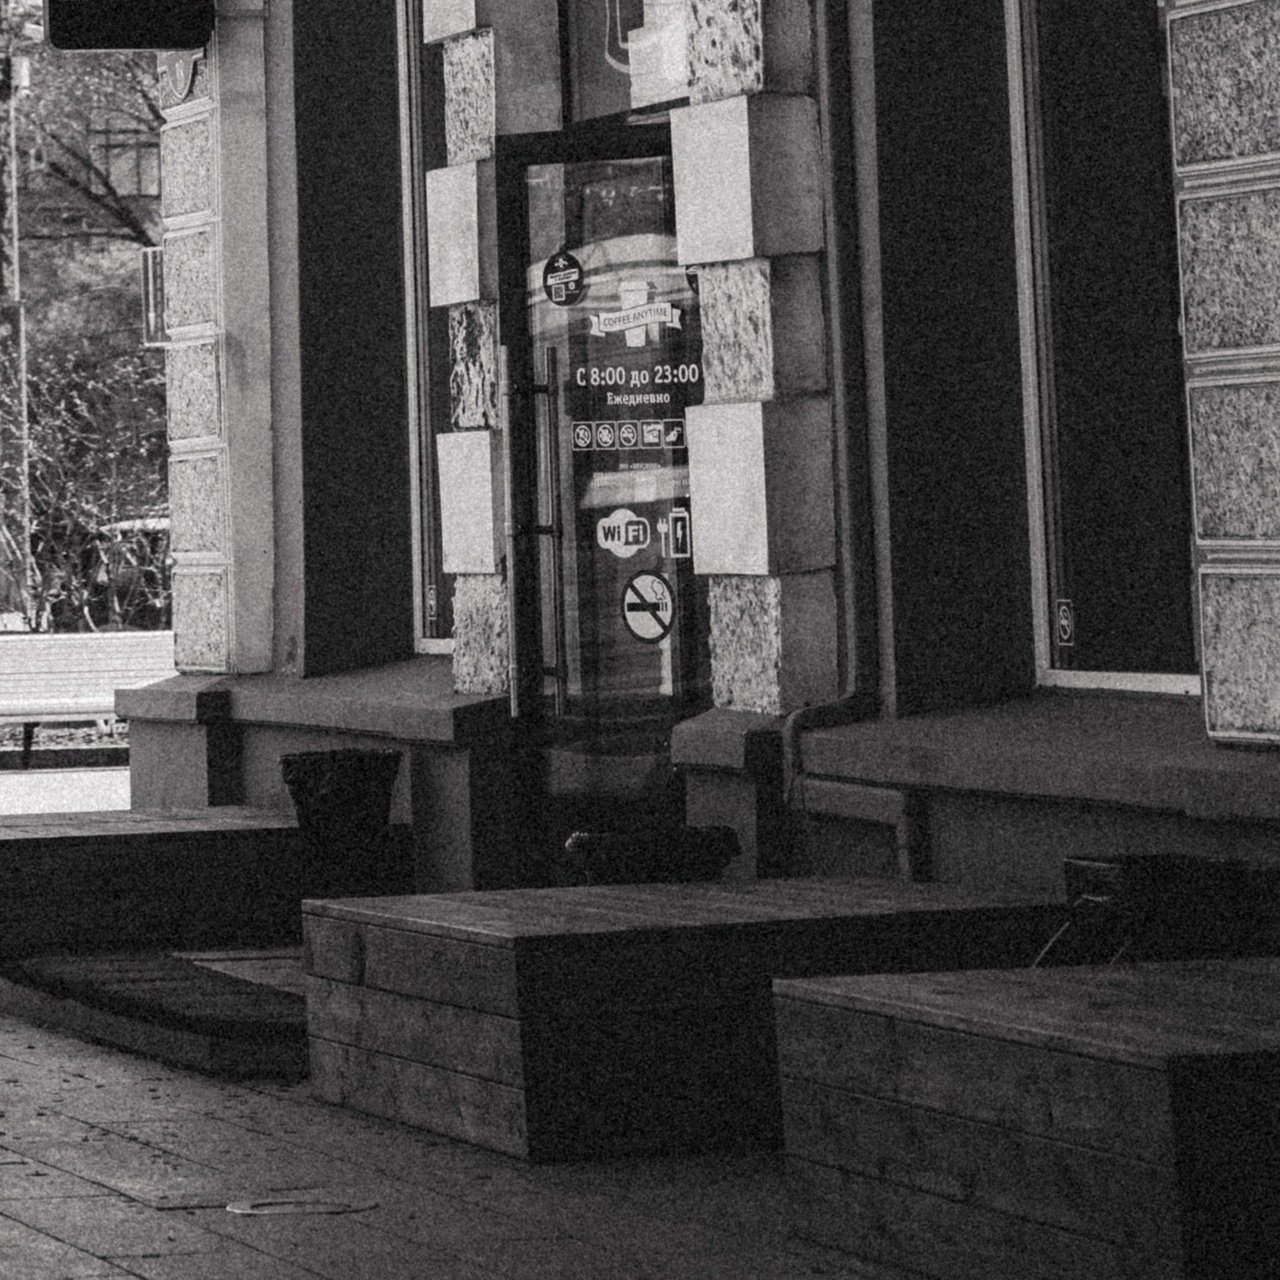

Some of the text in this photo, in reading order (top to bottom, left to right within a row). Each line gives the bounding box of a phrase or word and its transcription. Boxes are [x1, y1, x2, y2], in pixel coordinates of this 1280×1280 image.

[602, 306, 669, 328] COFFEE ANYTIME
[590, 366, 626, 386] 8:00
[629, 370, 650, 389] до
[653, 364, 700, 384] 23:00
[606, 392, 671, 407] Ежедневно
